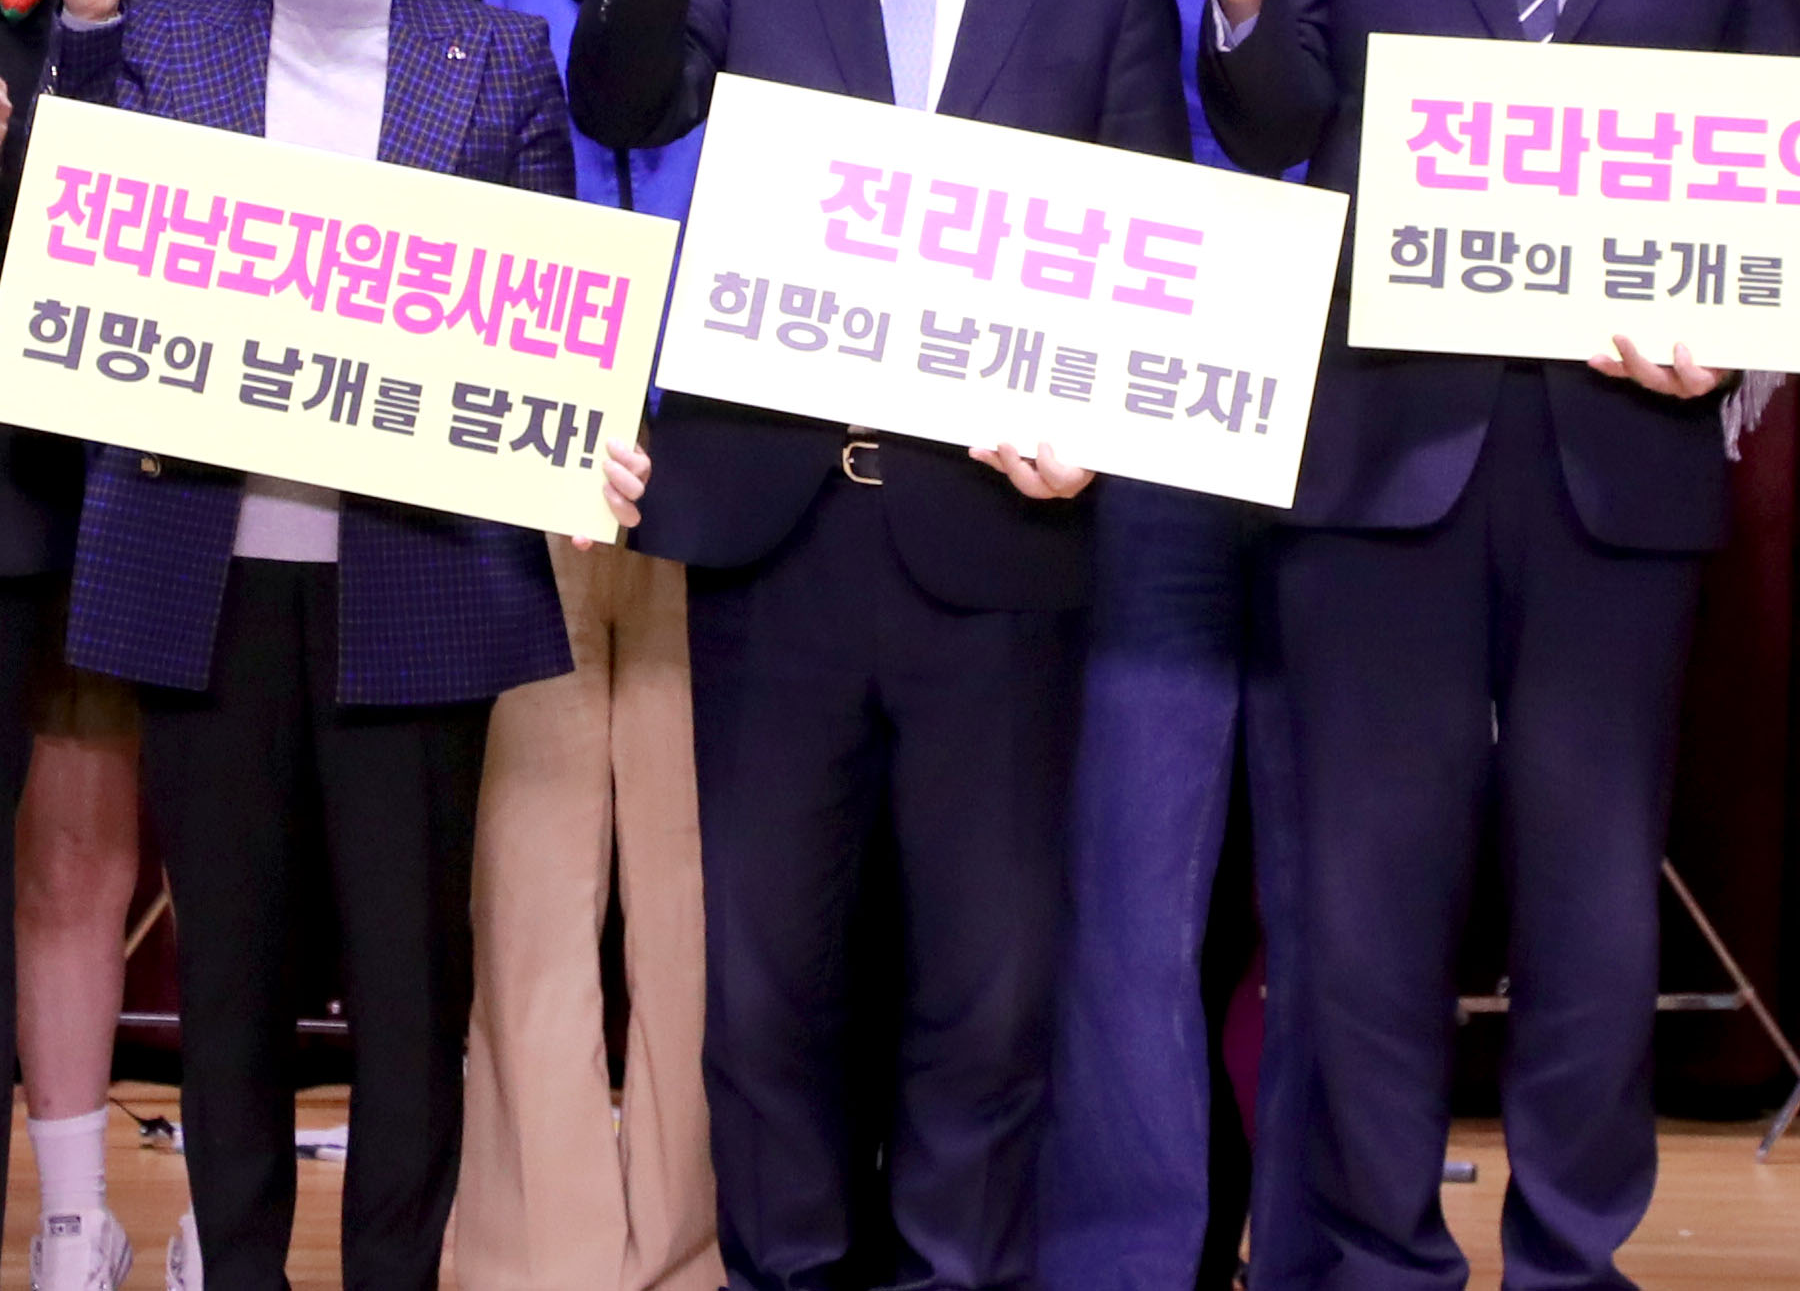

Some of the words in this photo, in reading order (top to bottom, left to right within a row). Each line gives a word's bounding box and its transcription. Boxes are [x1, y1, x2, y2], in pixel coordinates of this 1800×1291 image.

[46, 164, 631, 370] 전라남도자원봉사센터
[820, 159, 1205, 316] 전라남도
[1389, 223, 1572, 294] 희망의
[1601, 237, 1784, 309] 날개를
[23, 298, 213, 394] 희망의
[238, 339, 425, 437] 날개를
[448, 382, 605, 470] 달자!
[703, 271, 892, 362] 희망의
[916, 309, 1099, 403] 날개를
[1124, 349, 1279, 436] 달자!
